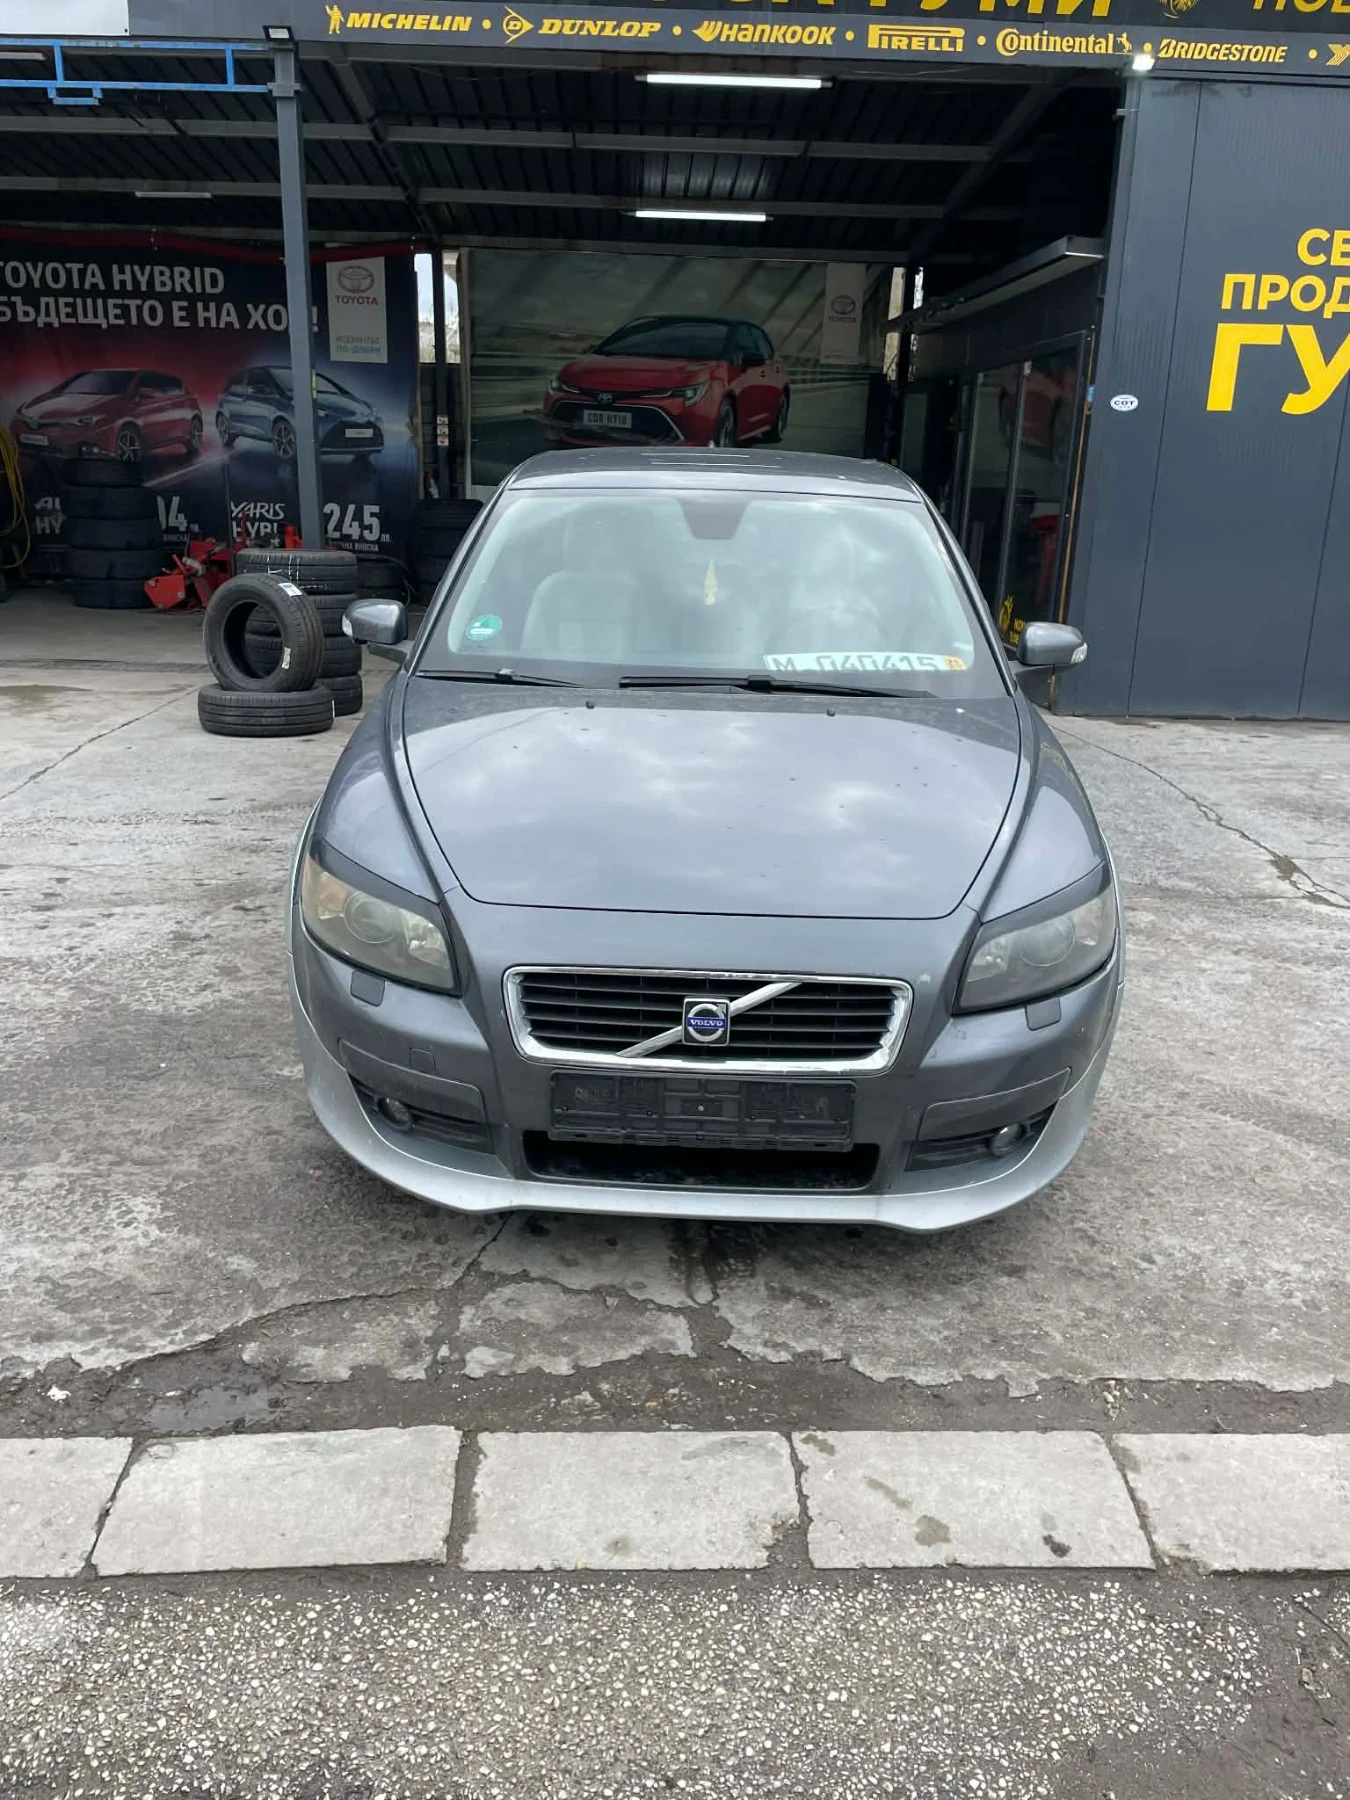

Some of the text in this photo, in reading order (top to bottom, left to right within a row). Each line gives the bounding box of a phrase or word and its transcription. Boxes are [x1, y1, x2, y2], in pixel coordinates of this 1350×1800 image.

[347, 12, 472, 32] MICHELIN
[538, 18, 662, 37] DUNLOP
[867, 24, 965, 52] PIRELLI
[996, 28, 1114, 56] Continental
[1158, 39, 1288, 63] BRIDGESTONE
[0, 260, 225, 294] OYOTA HYBRID
[336, 294, 380, 307] TOYOTA
[172, 300, 191, 328] Е
[197, 301, 241, 329] НА
[230, 500, 287, 520] YARIS
[323, 502, 381, 542] 245
[772, 656, 797, 671] M
[690, 1018, 724, 1027] VOLVO
